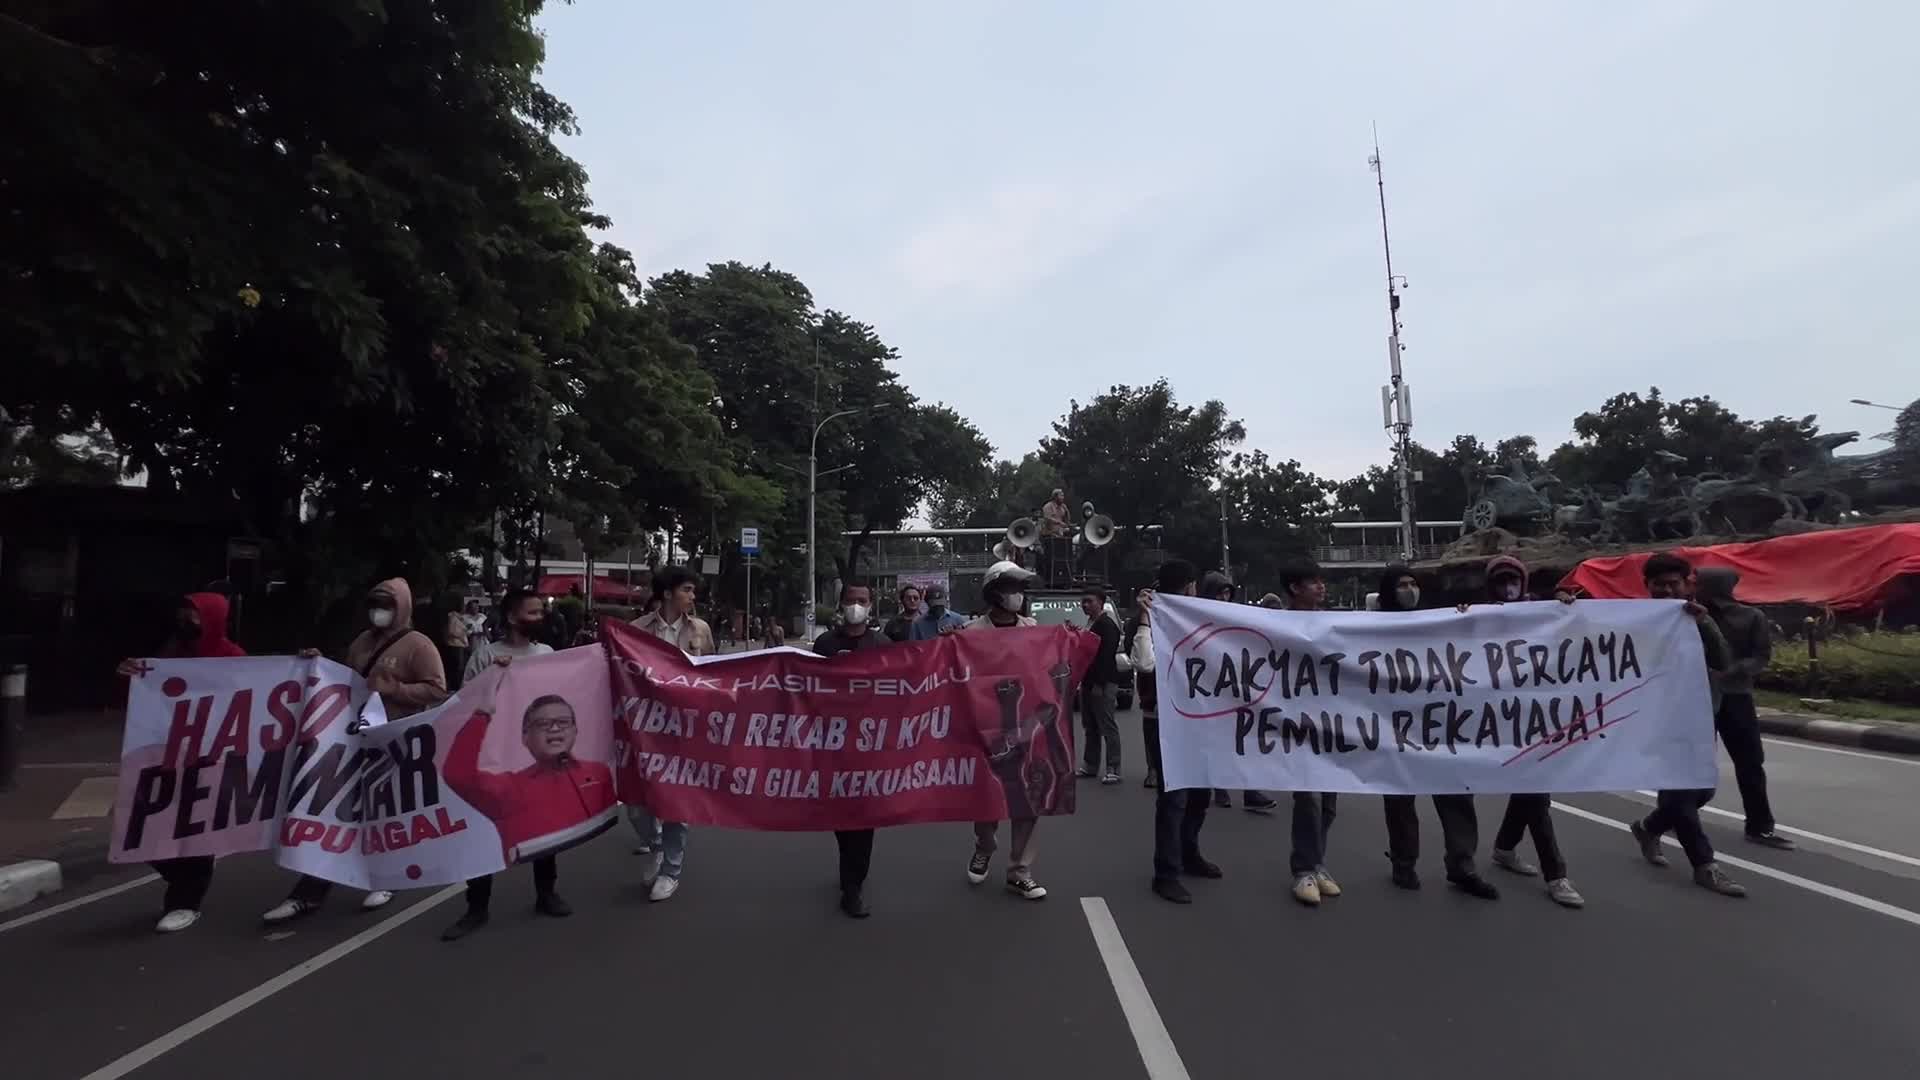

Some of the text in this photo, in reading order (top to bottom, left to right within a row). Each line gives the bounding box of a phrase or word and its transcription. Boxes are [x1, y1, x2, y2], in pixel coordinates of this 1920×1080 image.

[733, 673, 836, 693] HASIL
[849, 665, 971, 695] PEMILU
[1186, 632, 1641, 702] RAKYAT TIDAK PERCAYA
[706, 711, 736, 746] SI
[744, 713, 847, 750] REKAB
[856, 717, 888, 751] SI
[897, 705, 951, 750] KPU
[1235, 692, 1606, 755] PEMILU REKAYASA!
[729, 766, 759, 795] SI
[764, 768, 820, 798] GILA
[829, 757, 976, 798] KEKUASAAN
